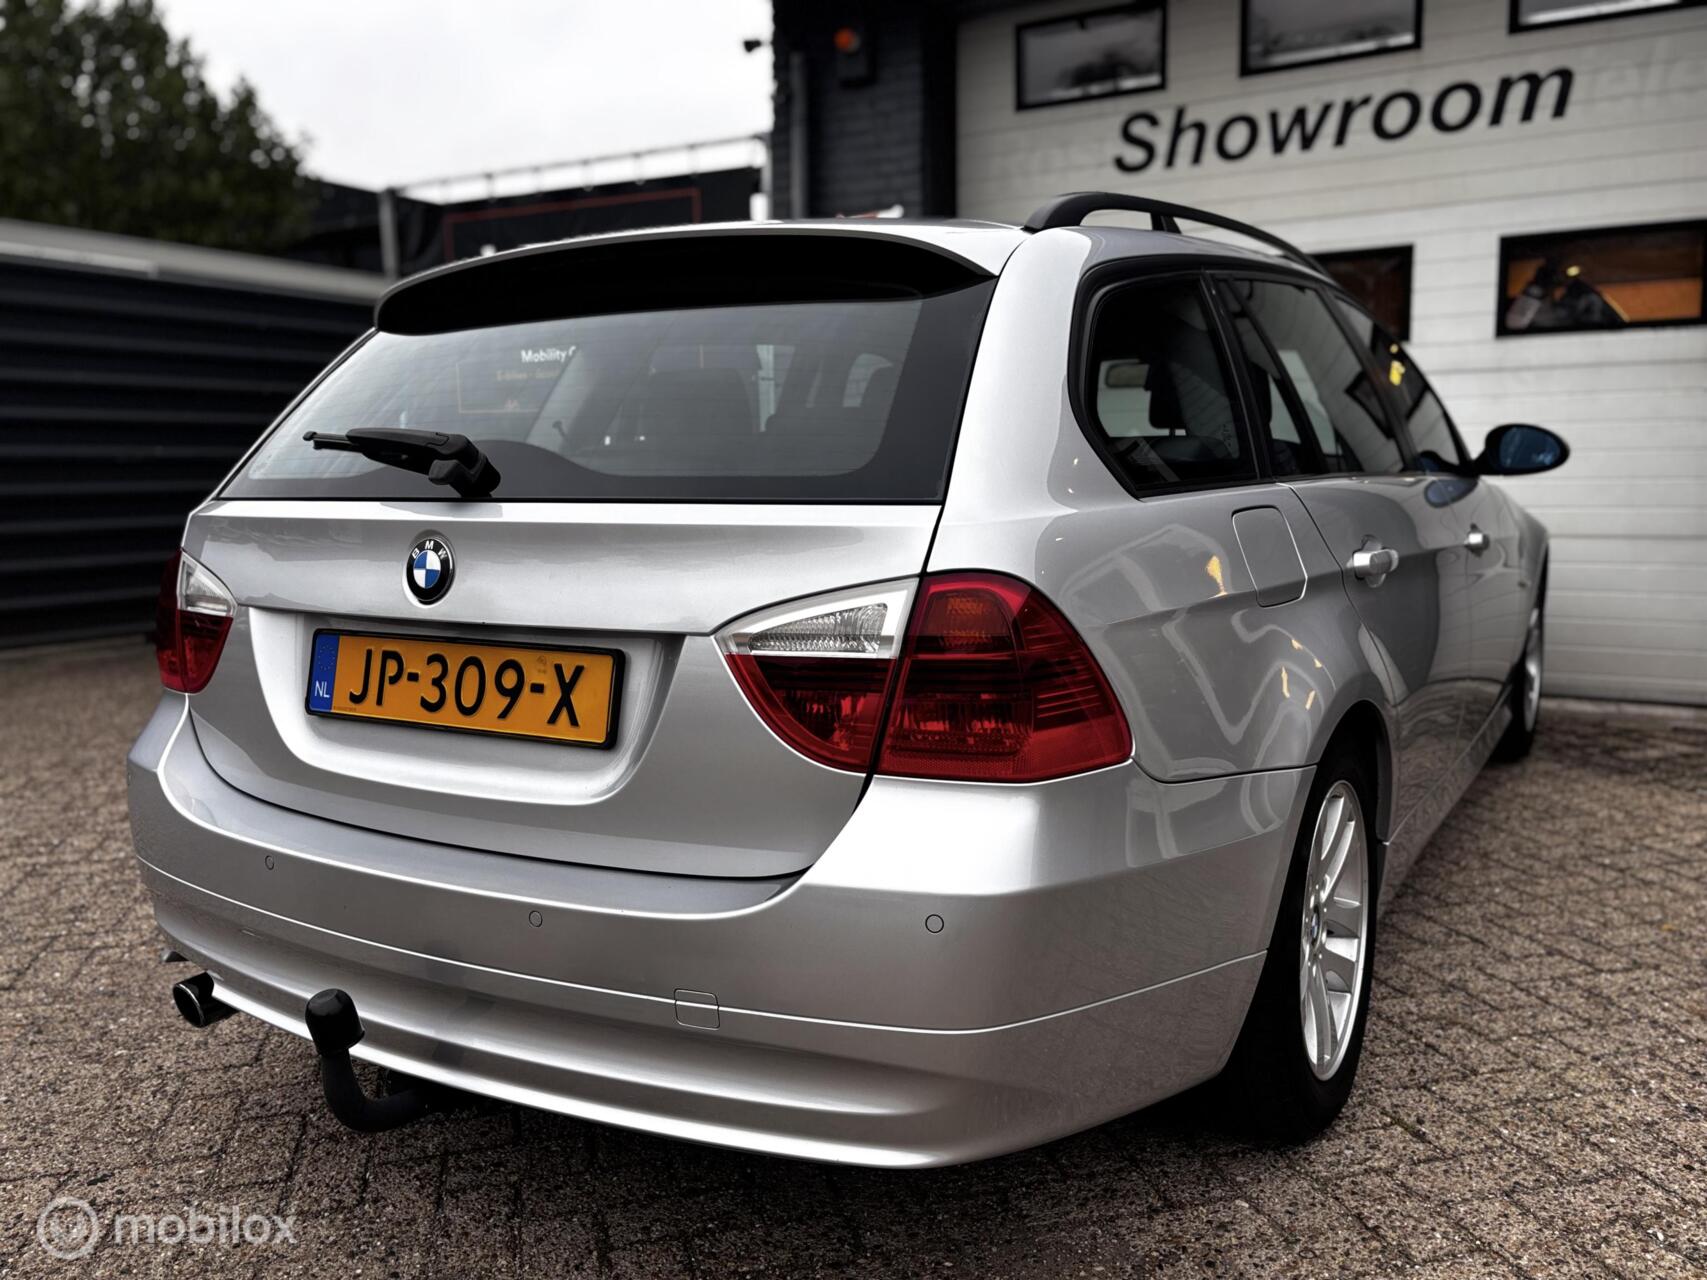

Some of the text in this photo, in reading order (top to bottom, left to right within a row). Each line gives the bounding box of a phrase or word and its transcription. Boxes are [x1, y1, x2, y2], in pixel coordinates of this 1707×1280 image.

[1113, 65, 1574, 174] Showroom
[520, 348, 567, 363] Mobility
[411, 540, 448, 560] BMW
[314, 680, 331, 699] NL
[349, 648, 585, 728] JP-309-X
